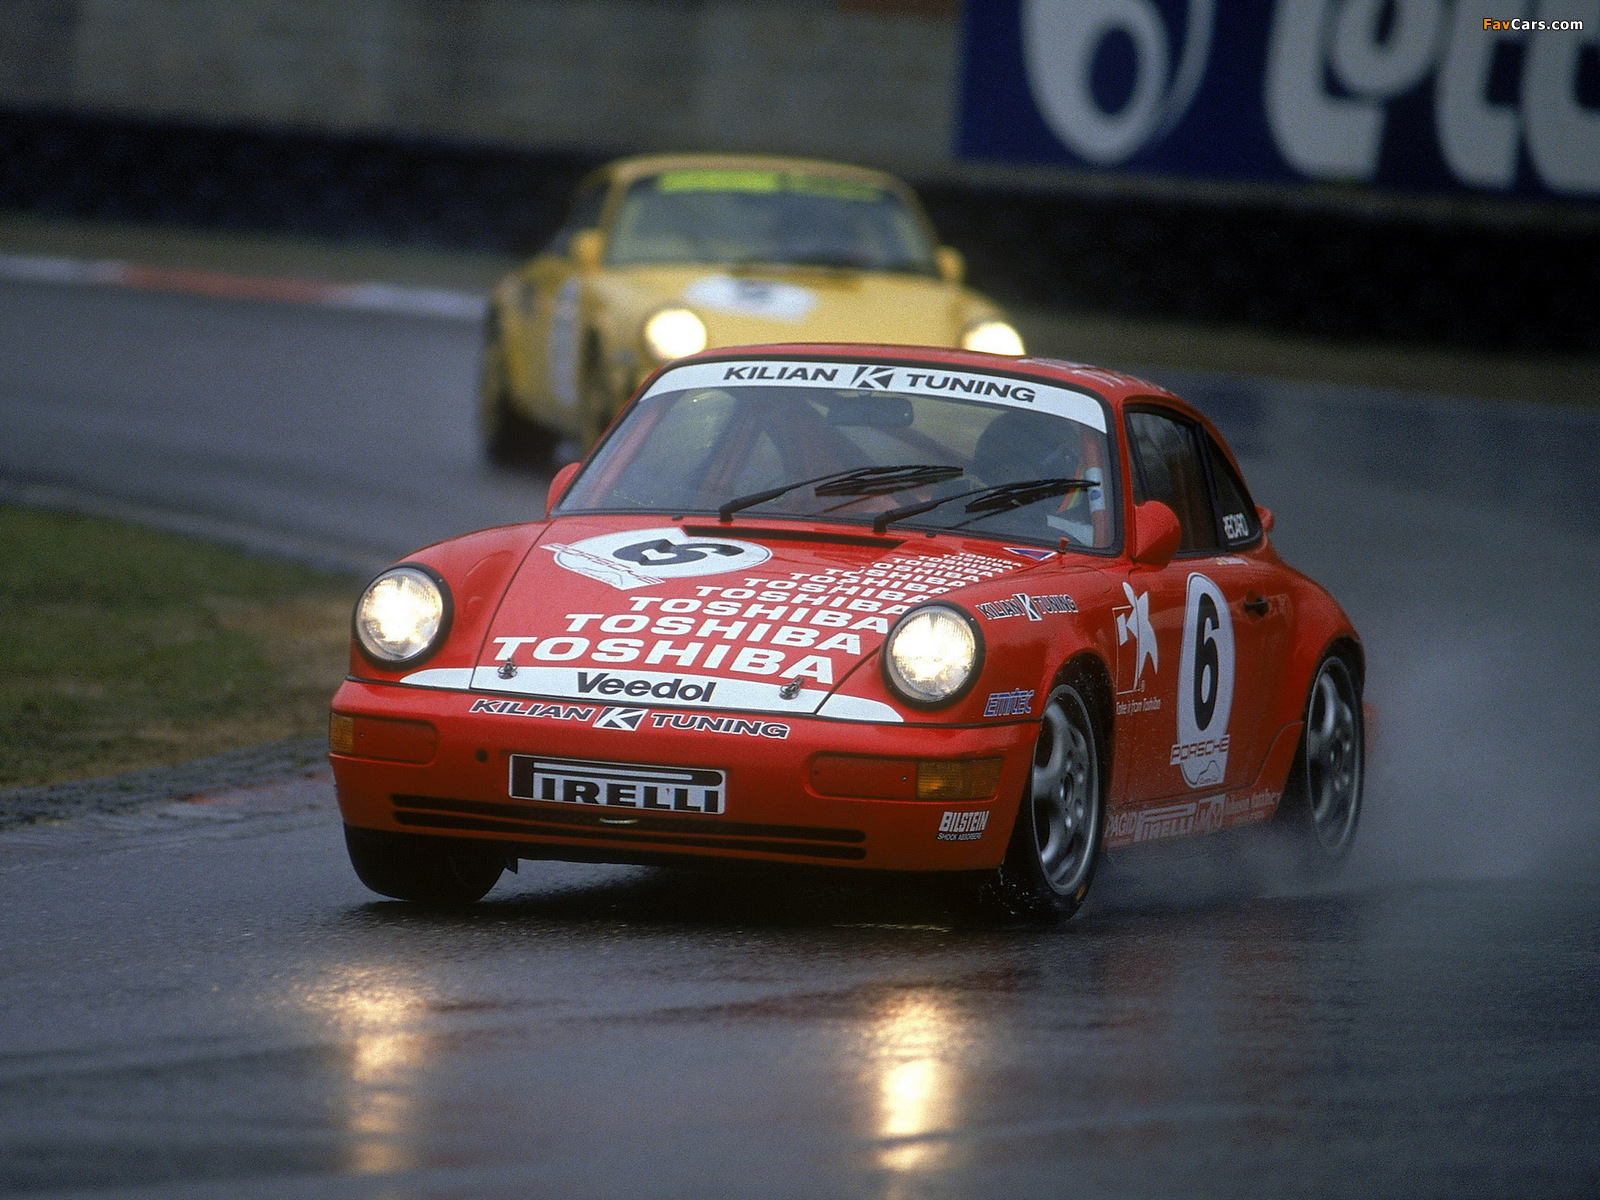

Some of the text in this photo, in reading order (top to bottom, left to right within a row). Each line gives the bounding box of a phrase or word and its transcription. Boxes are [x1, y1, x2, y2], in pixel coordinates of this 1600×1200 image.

[723, 365, 839, 384] KILIAN
[906, 373, 1036, 403] TUNING
[612, 538, 744, 567] 6
[892, 557, 993, 577] TOSHIBA
[918, 555, 1004, 573] TOSHIBA
[694, 585, 912, 616] TOSHIBA
[743, 577, 931, 603] TOSHIBA
[628, 596, 889, 635] TOSHIBA
[974, 598, 1025, 620] KILIAN
[1031, 594, 1079, 614] TUNING
[564, 613, 862, 656] TOSHIBA
[492, 635, 834, 685] TOSHIBA
[1194, 592, 1219, 731] 6
[577, 671, 717, 703] Veedol
[469, 699, 594, 721] KILIAN
[650, 713, 790, 739] TUNING
[1170, 734, 1231, 765] PORSCHE
[510, 753, 726, 815] PIRELLI
[938, 810, 990, 832] BILSTEIN
[1134, 802, 1198, 842] PIRELLI
